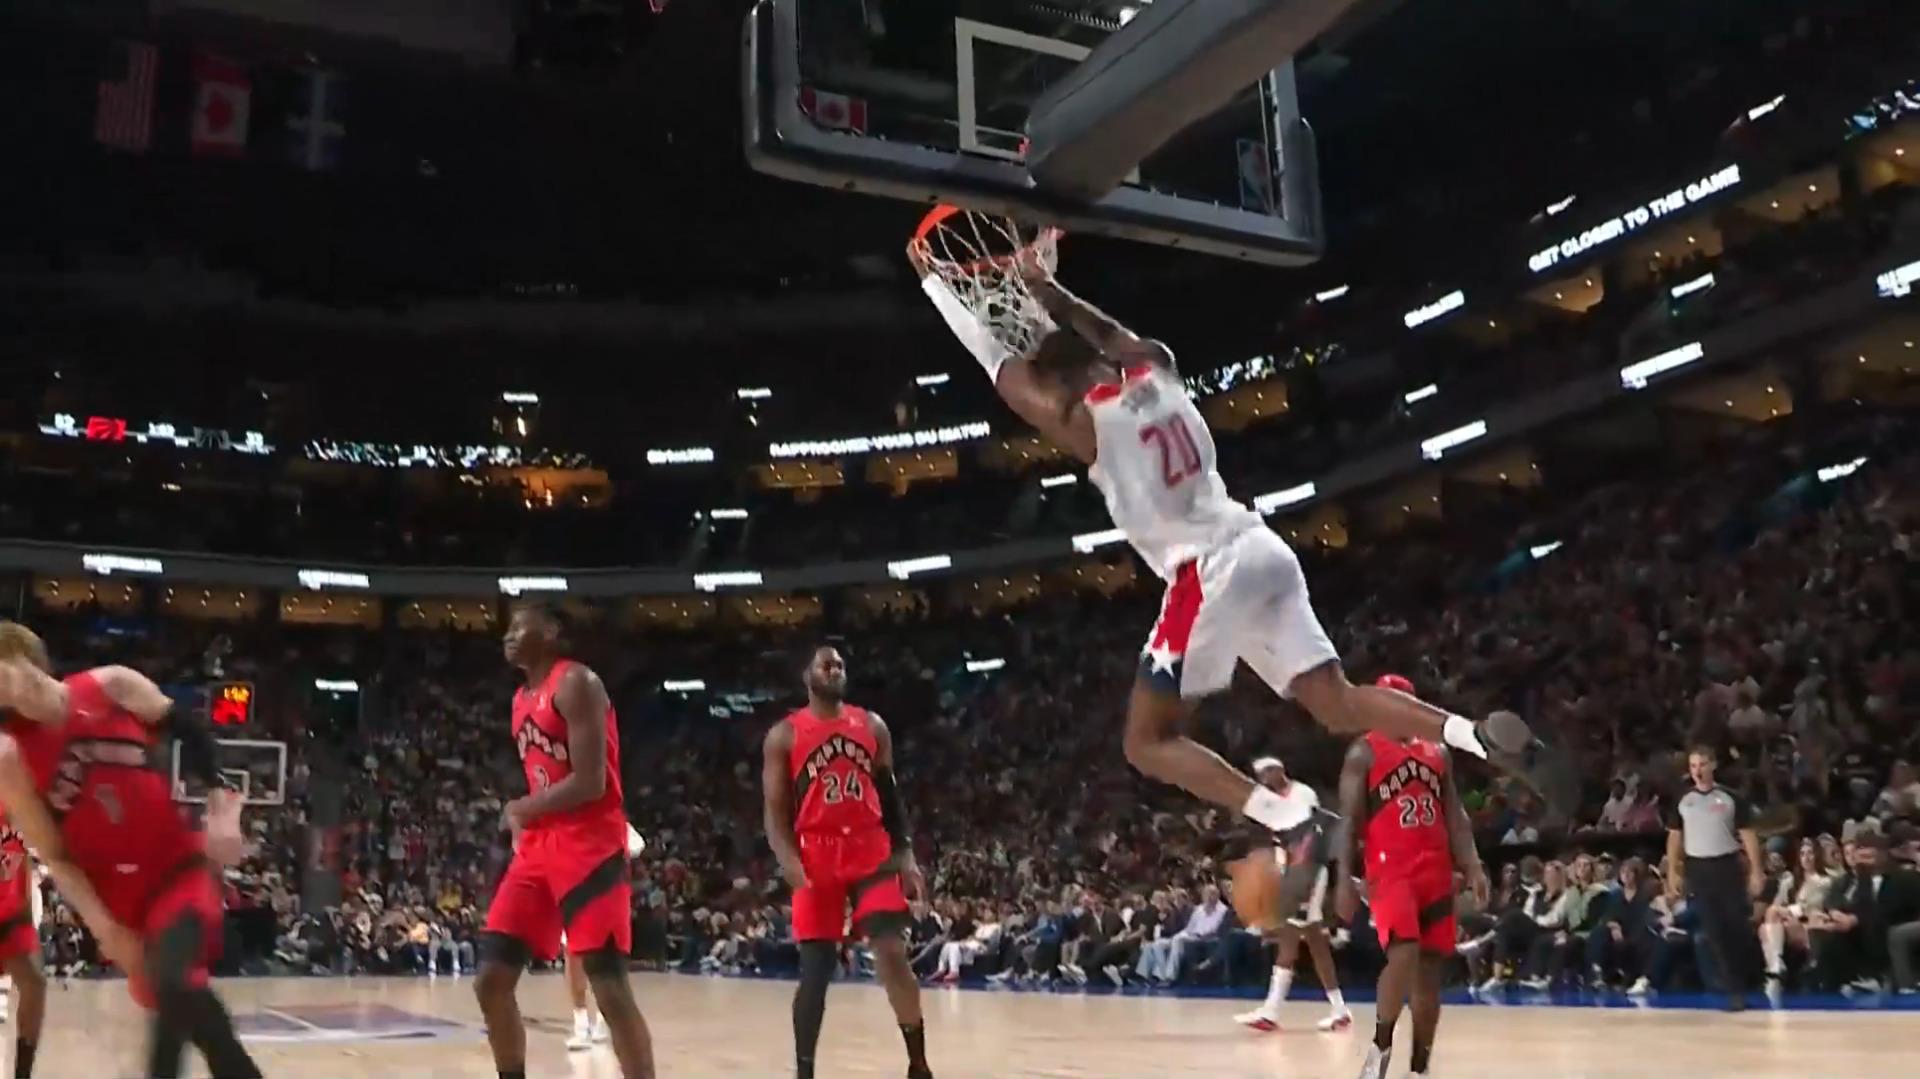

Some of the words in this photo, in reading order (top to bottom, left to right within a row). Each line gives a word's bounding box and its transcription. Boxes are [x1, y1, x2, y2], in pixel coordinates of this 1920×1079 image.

[1529, 245, 1559, 272] GET
[1561, 218, 1624, 258] CLOSER
[1624, 206, 1649, 230] TO
[1649, 189, 1687, 218] THE
[1686, 163, 1740, 202] GAME
[914, 430, 938, 444] DU
[938, 421, 990, 442] MATCH
[1138, 412, 1202, 488] 20
[821, 771, 864, 804] 24
[1397, 794, 1436, 828] 23
